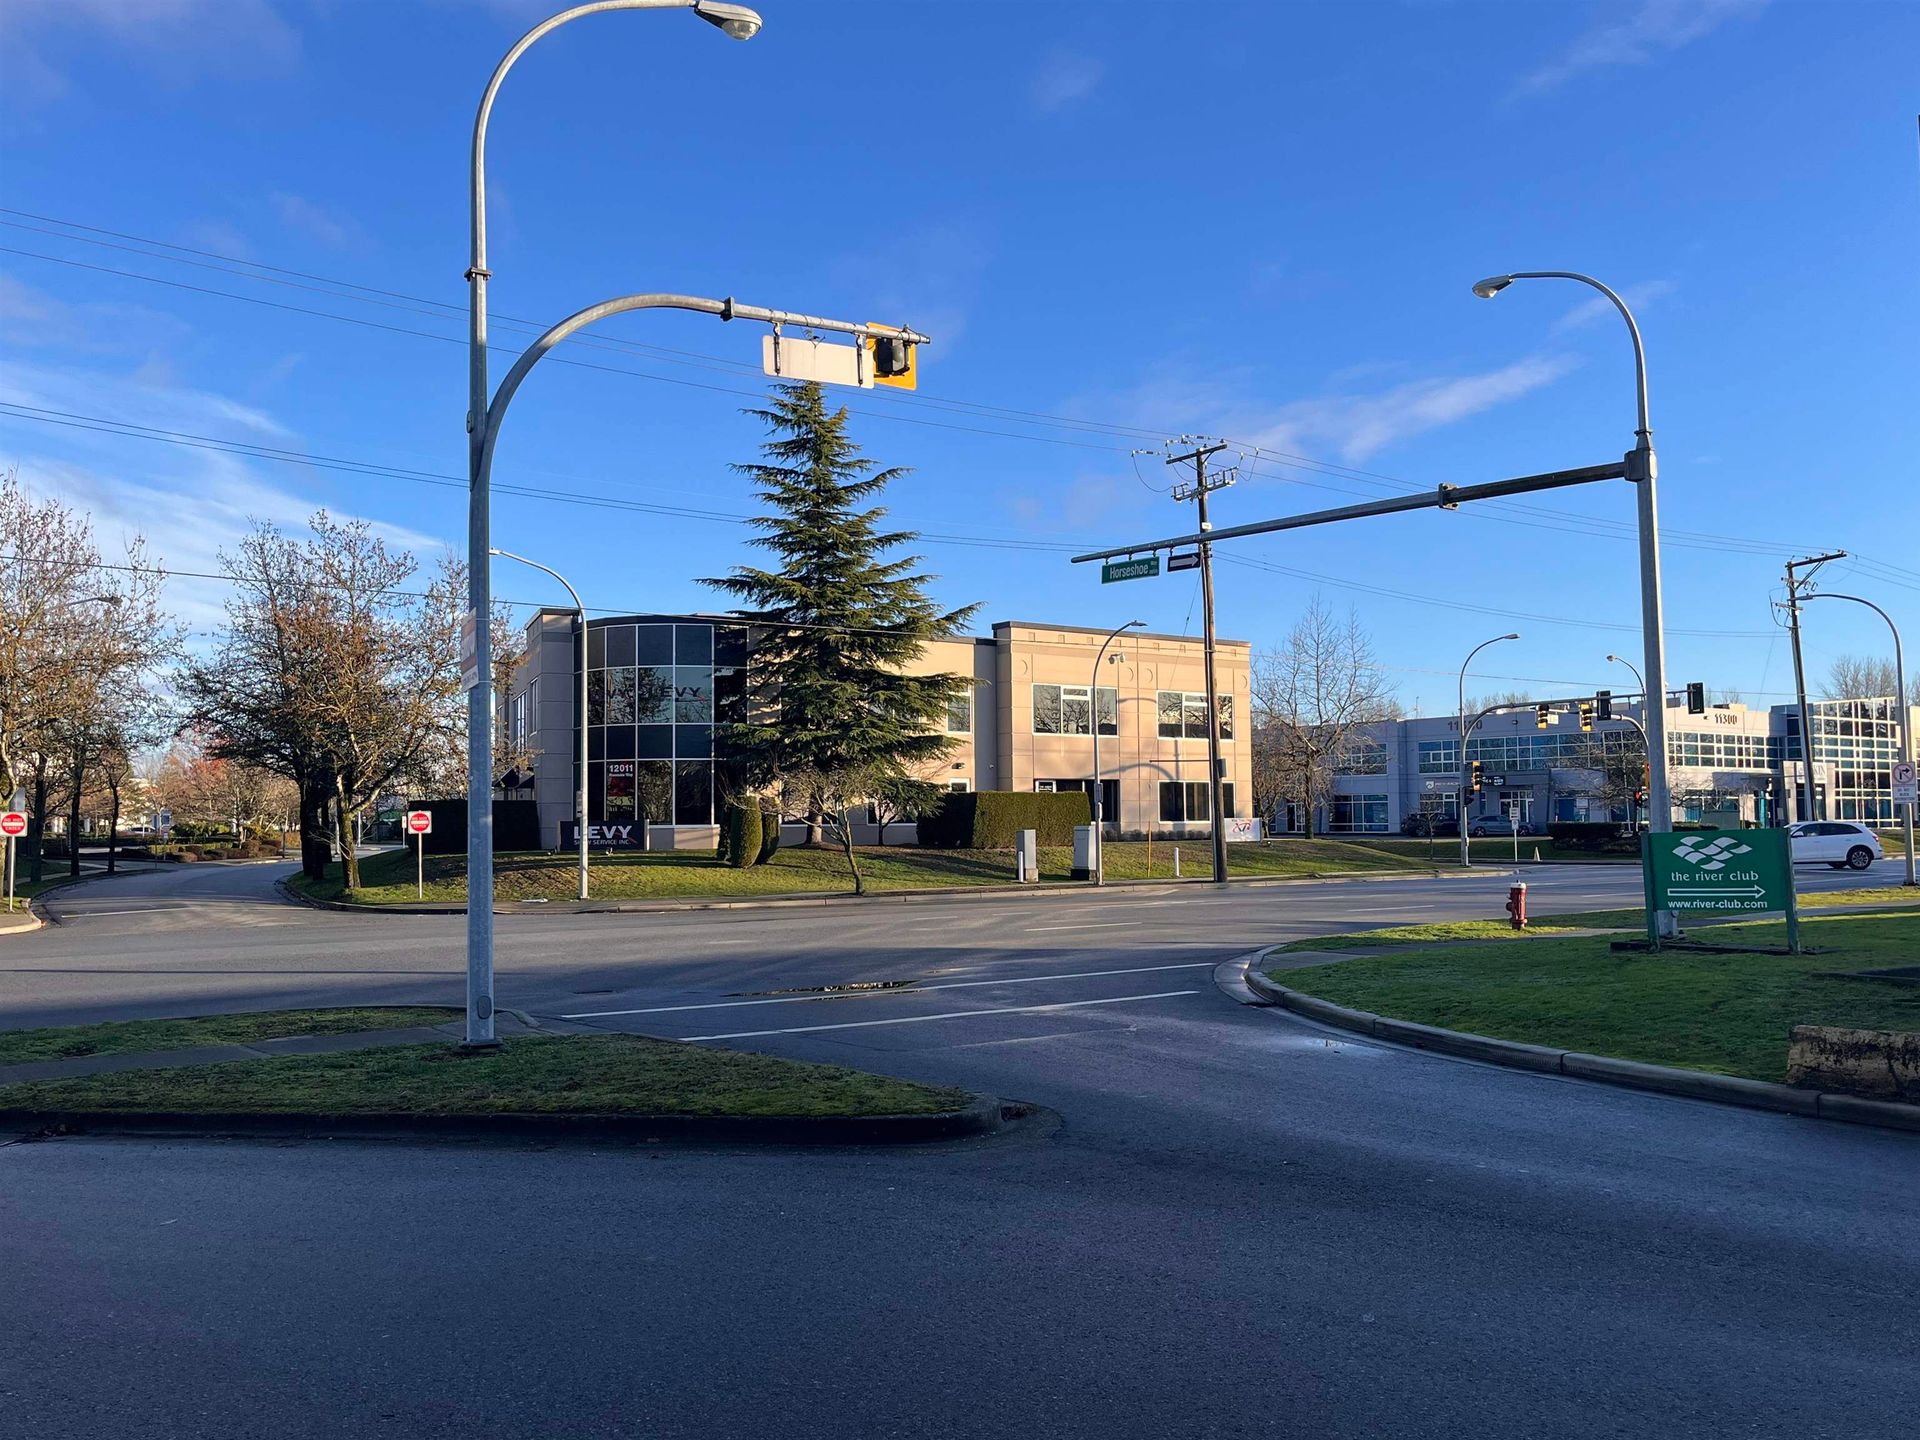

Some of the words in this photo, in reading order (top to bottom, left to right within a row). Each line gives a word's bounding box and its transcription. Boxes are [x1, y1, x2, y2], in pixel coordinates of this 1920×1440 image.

[1109, 563, 1149, 579] Horseshoe
[1714, 713, 1738, 725] 11300
[609, 764, 633, 773] 12011
[573, 825, 633, 839] LEVY
[1671, 871, 1690, 881] the
[1695, 871, 1724, 881] river
[1729, 870, 1759, 881] club
[1667, 899, 1768, 909] www.river-club.com
